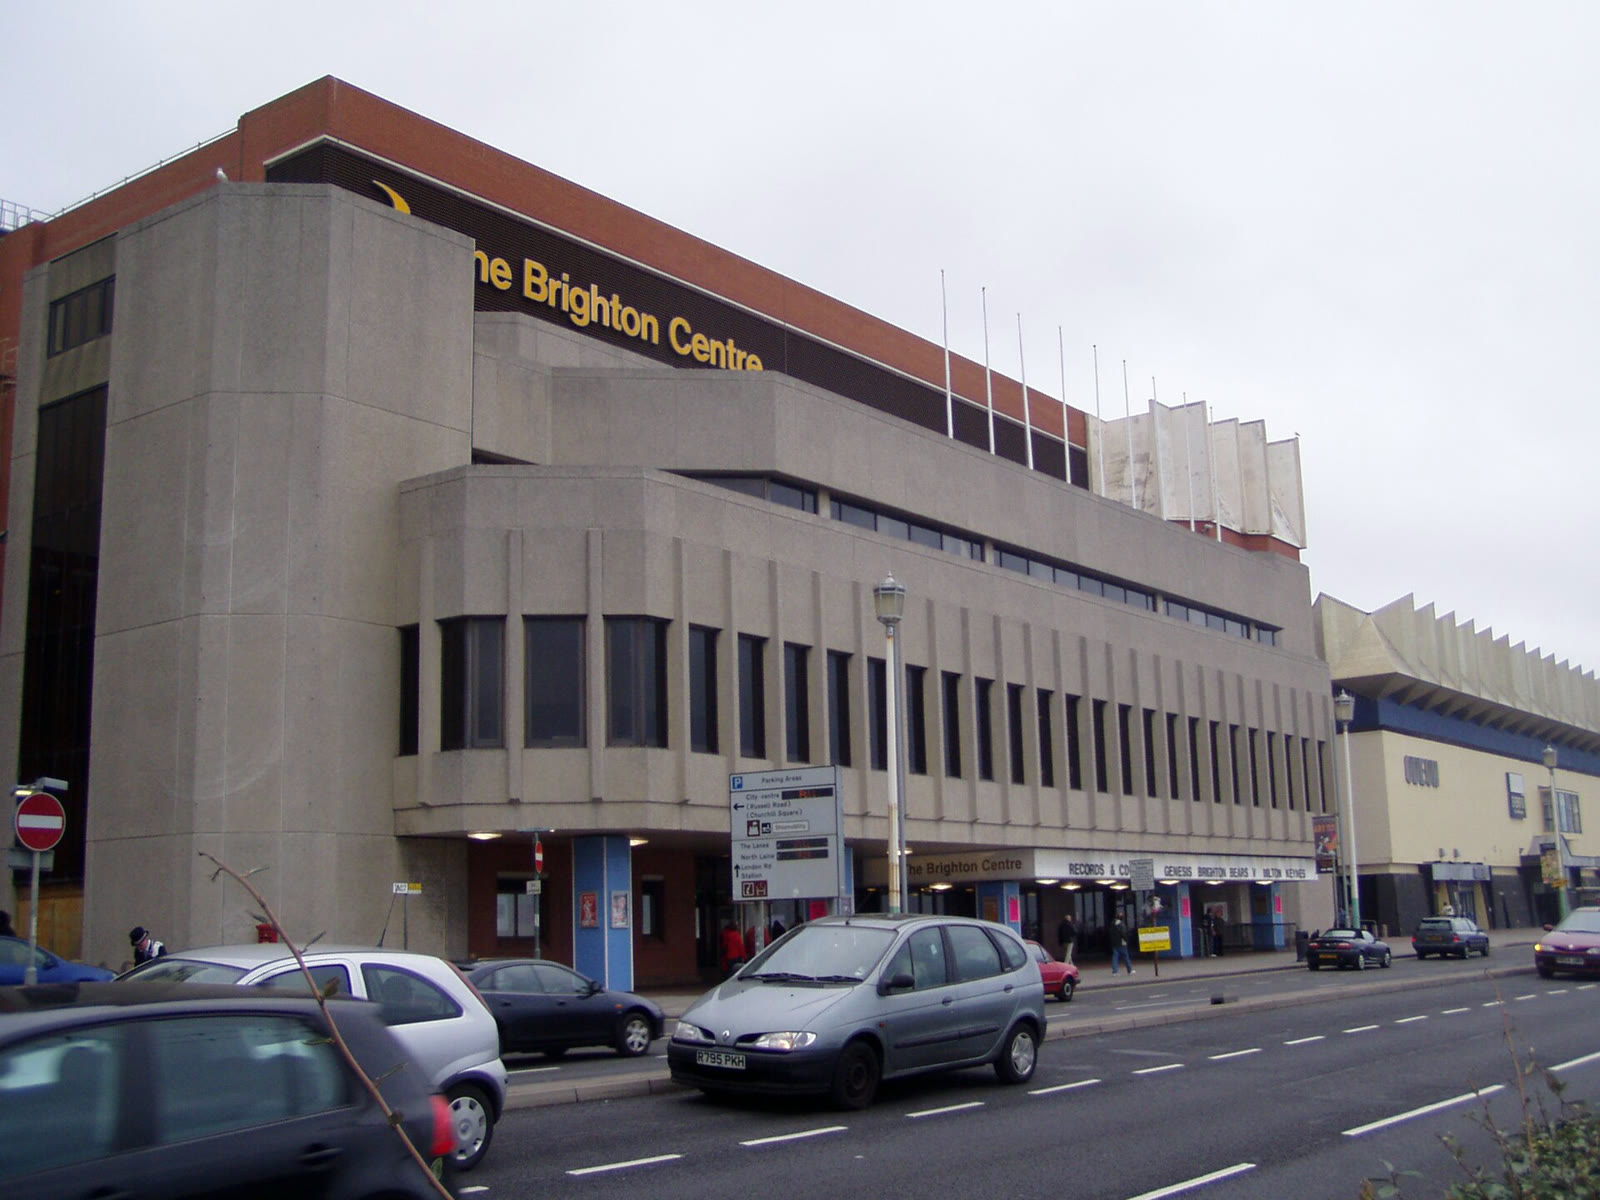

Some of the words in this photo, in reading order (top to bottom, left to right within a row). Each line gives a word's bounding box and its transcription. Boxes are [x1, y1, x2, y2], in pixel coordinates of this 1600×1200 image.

[523, 258, 659, 345] Brighton
[669, 317, 763, 371] Centre
[926, 860, 978, 877] Brighton
[981, 858, 1022, 871] Centre
[1069, 863, 1105, 875] RECORDS
[1110, 864, 1115, 876] &
[1164, 865, 1193, 877] GENESIS
[1197, 866, 1226, 878] BRIGHTON
[1229, 867, 1249, 878] BEARS
[1285, 868, 1306, 879] KEYNES
[697, 1051, 722, 1065] R795
[724, 1054, 745, 1067] PKH
